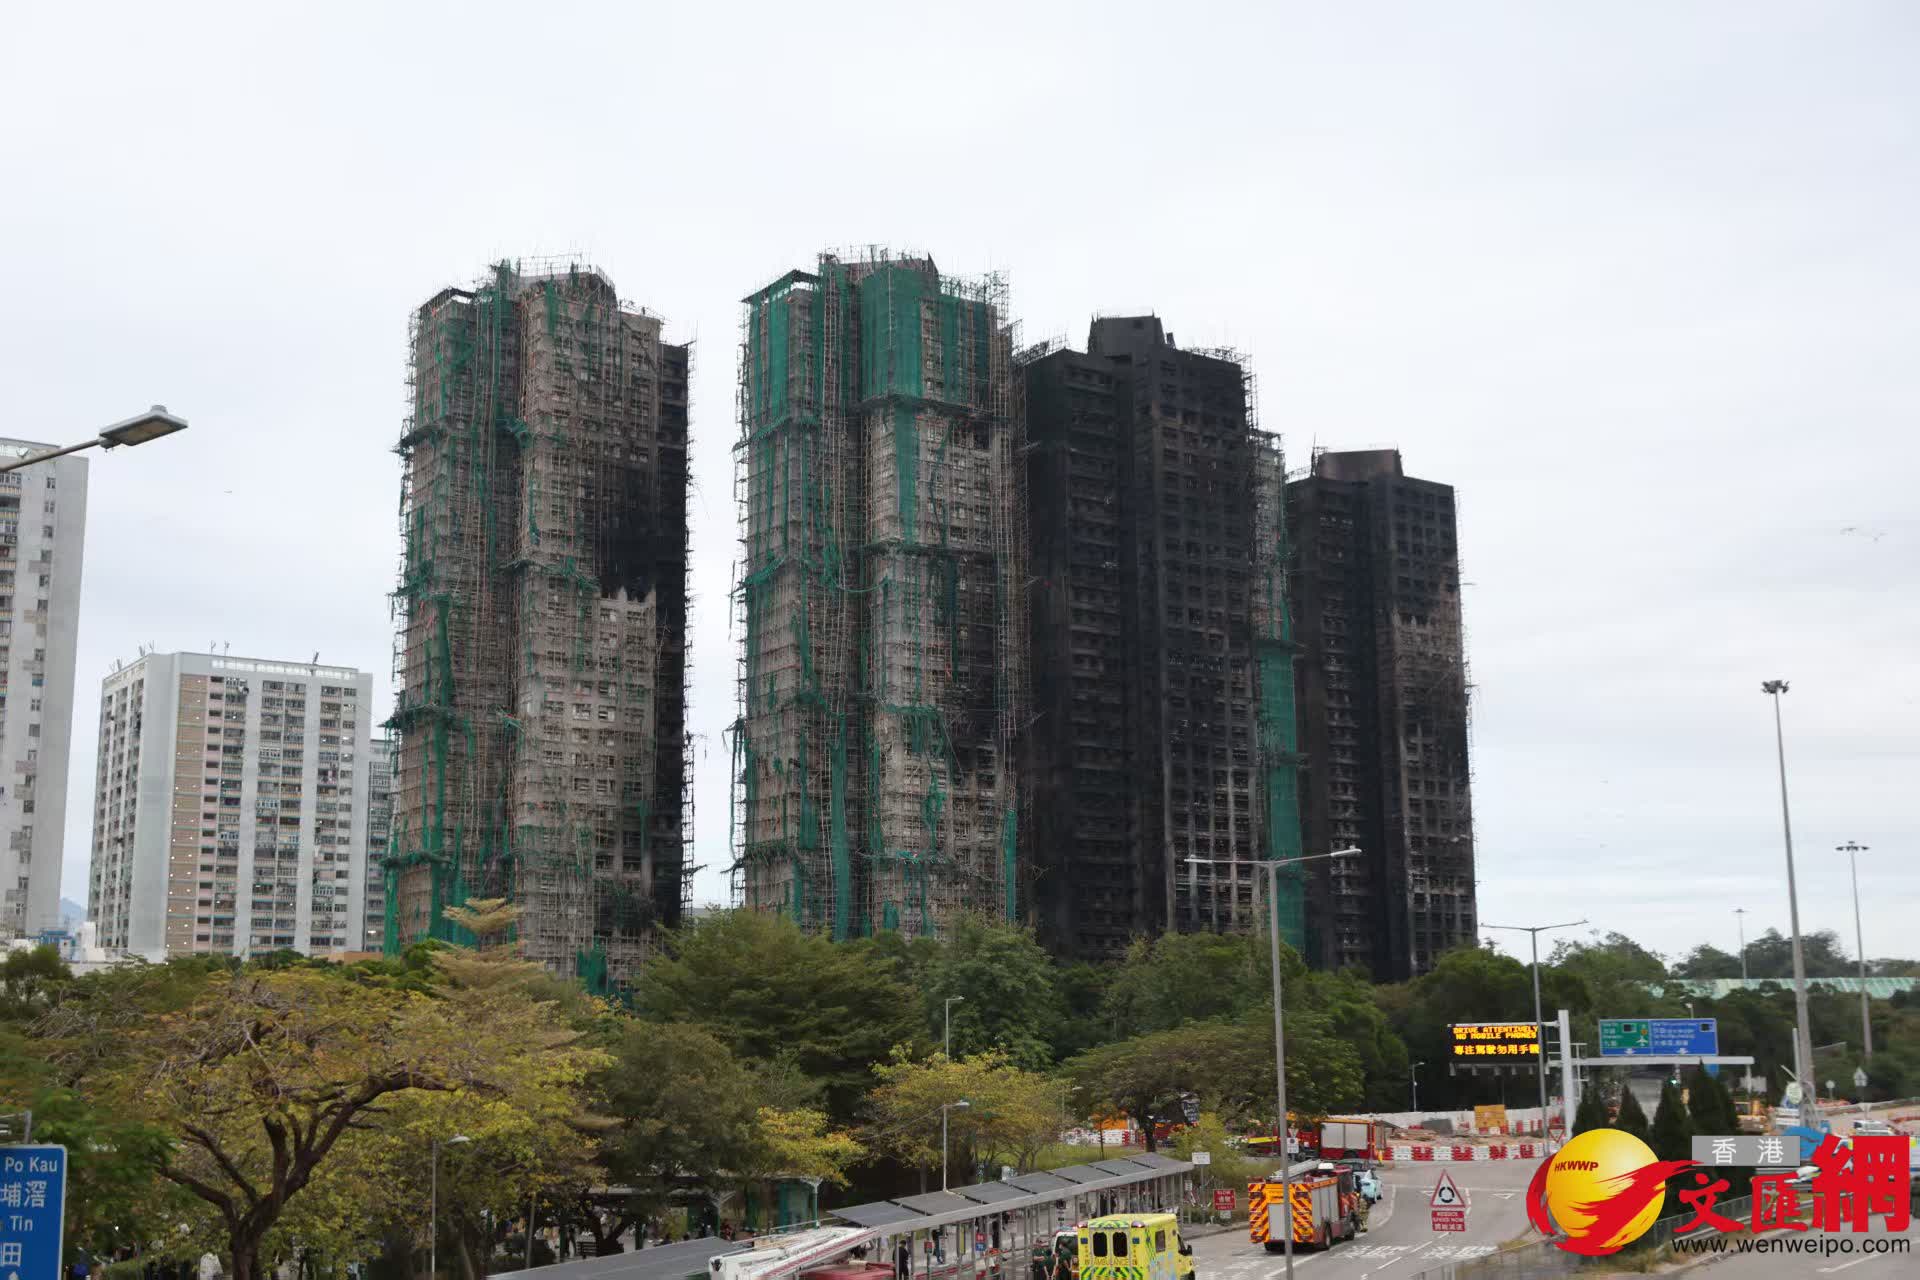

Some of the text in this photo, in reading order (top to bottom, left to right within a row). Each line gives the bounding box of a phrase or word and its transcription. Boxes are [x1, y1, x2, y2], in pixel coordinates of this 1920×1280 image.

[1483, 1025, 1538, 1034] ATTENTIVELY
[1505, 1031, 1537, 1039] PHONES
[5, 1156, 58, 1172] Po Kau
[10, 1215, 33, 1231] Tin
